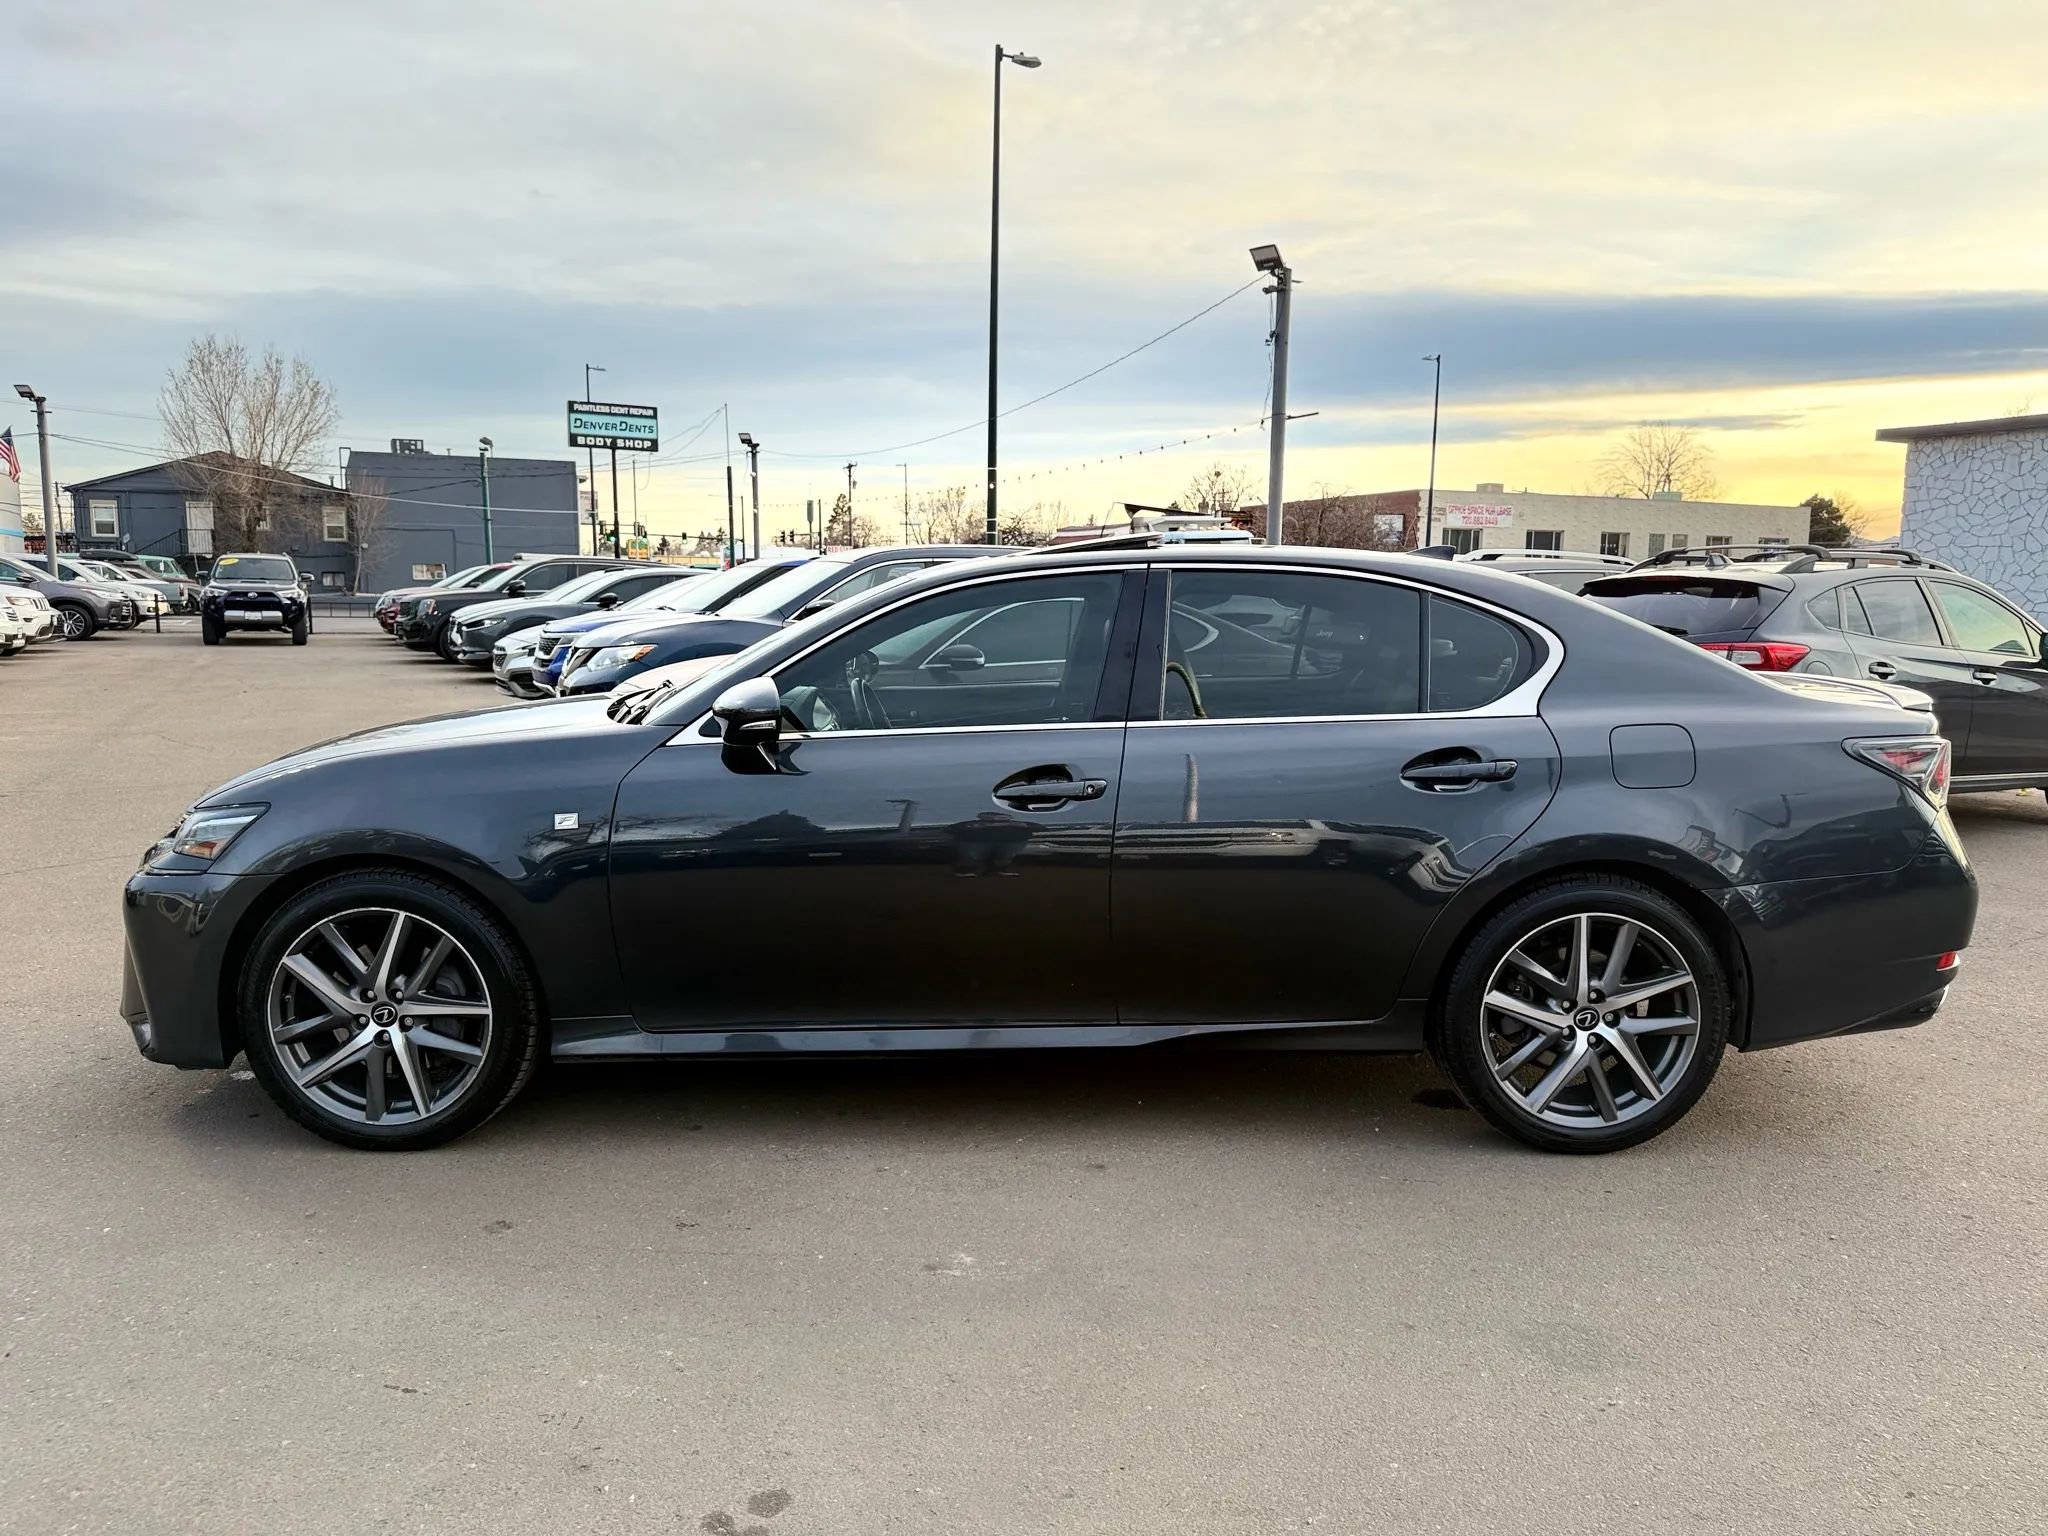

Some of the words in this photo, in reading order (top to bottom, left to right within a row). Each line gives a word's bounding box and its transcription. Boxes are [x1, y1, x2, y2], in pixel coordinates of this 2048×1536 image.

[574, 404, 610, 413] PAINTLESS
[611, 406, 629, 414] DENT
[630, 407, 654, 416] REPAIR
[577, 436, 613, 446] BODY
[616, 438, 652, 449] SHOP
[1497, 507, 1512, 516] LEASE
